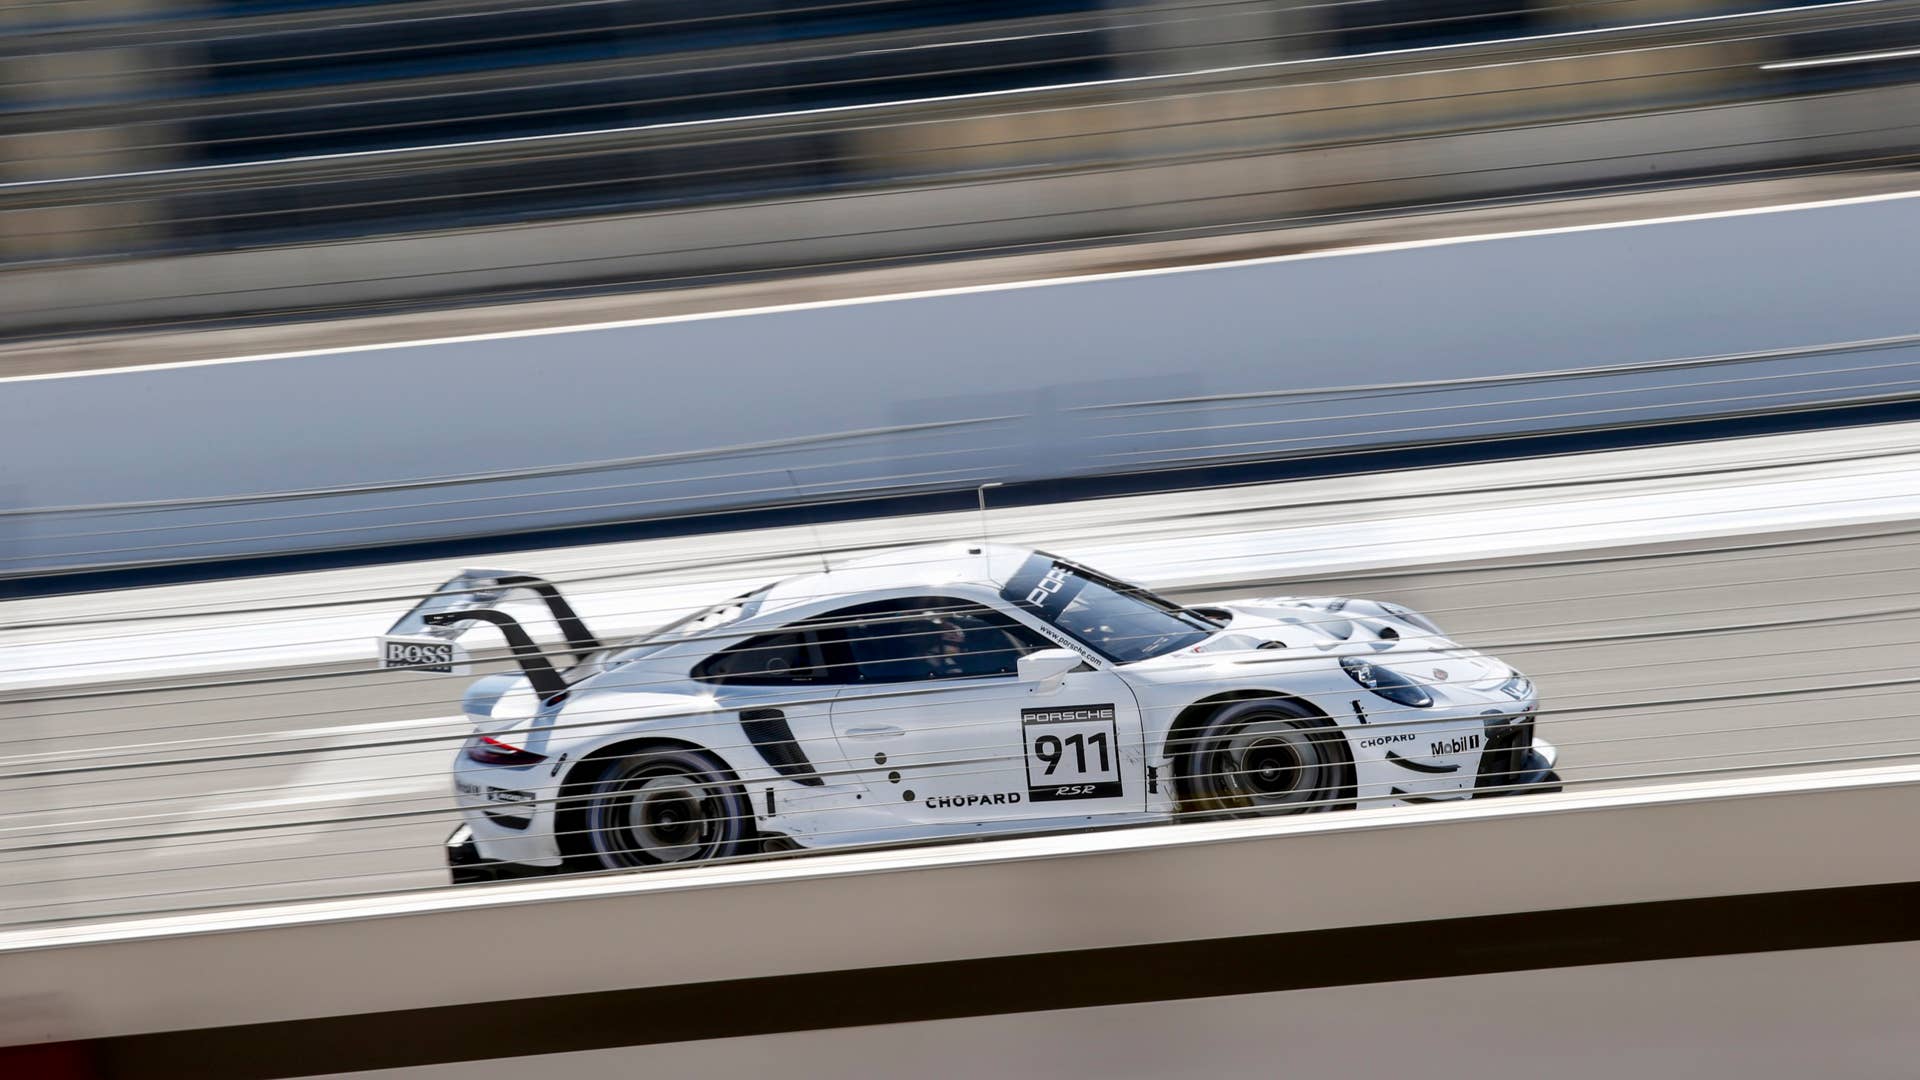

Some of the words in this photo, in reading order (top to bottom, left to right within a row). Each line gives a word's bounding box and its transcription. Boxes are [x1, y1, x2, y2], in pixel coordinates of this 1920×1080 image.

[388, 644, 450, 664] BOSS
[1040, 624, 1102, 666] www.porsche.com
[1023, 708, 1114, 723] PORSCHE
[1360, 733, 1416, 749] CHOPARD
[1431, 736, 1468, 756] Mobil
[1034, 732, 1110, 775] 911
[1055, 785, 1097, 796] RSR
[925, 792, 1021, 809] CHOPARD
